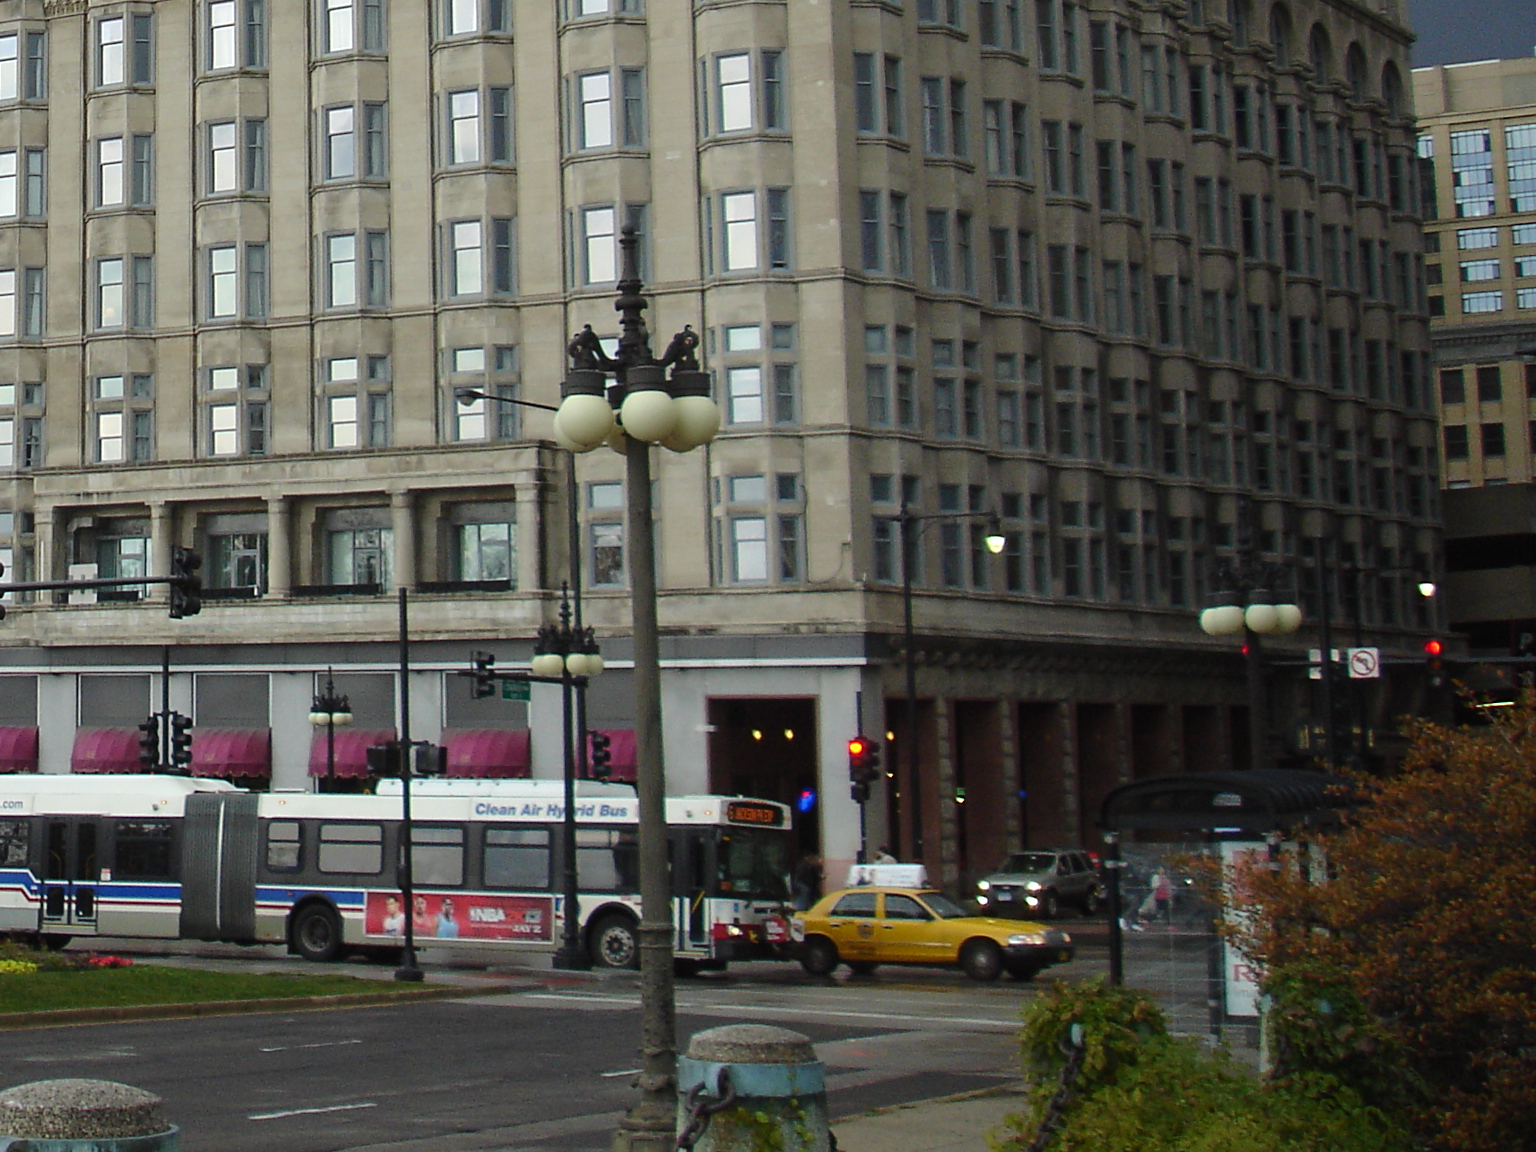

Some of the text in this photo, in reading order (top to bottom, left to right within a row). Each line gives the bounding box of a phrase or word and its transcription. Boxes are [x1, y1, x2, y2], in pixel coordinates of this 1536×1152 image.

[475, 802, 628, 819] Clean Air Hyrid Bus
